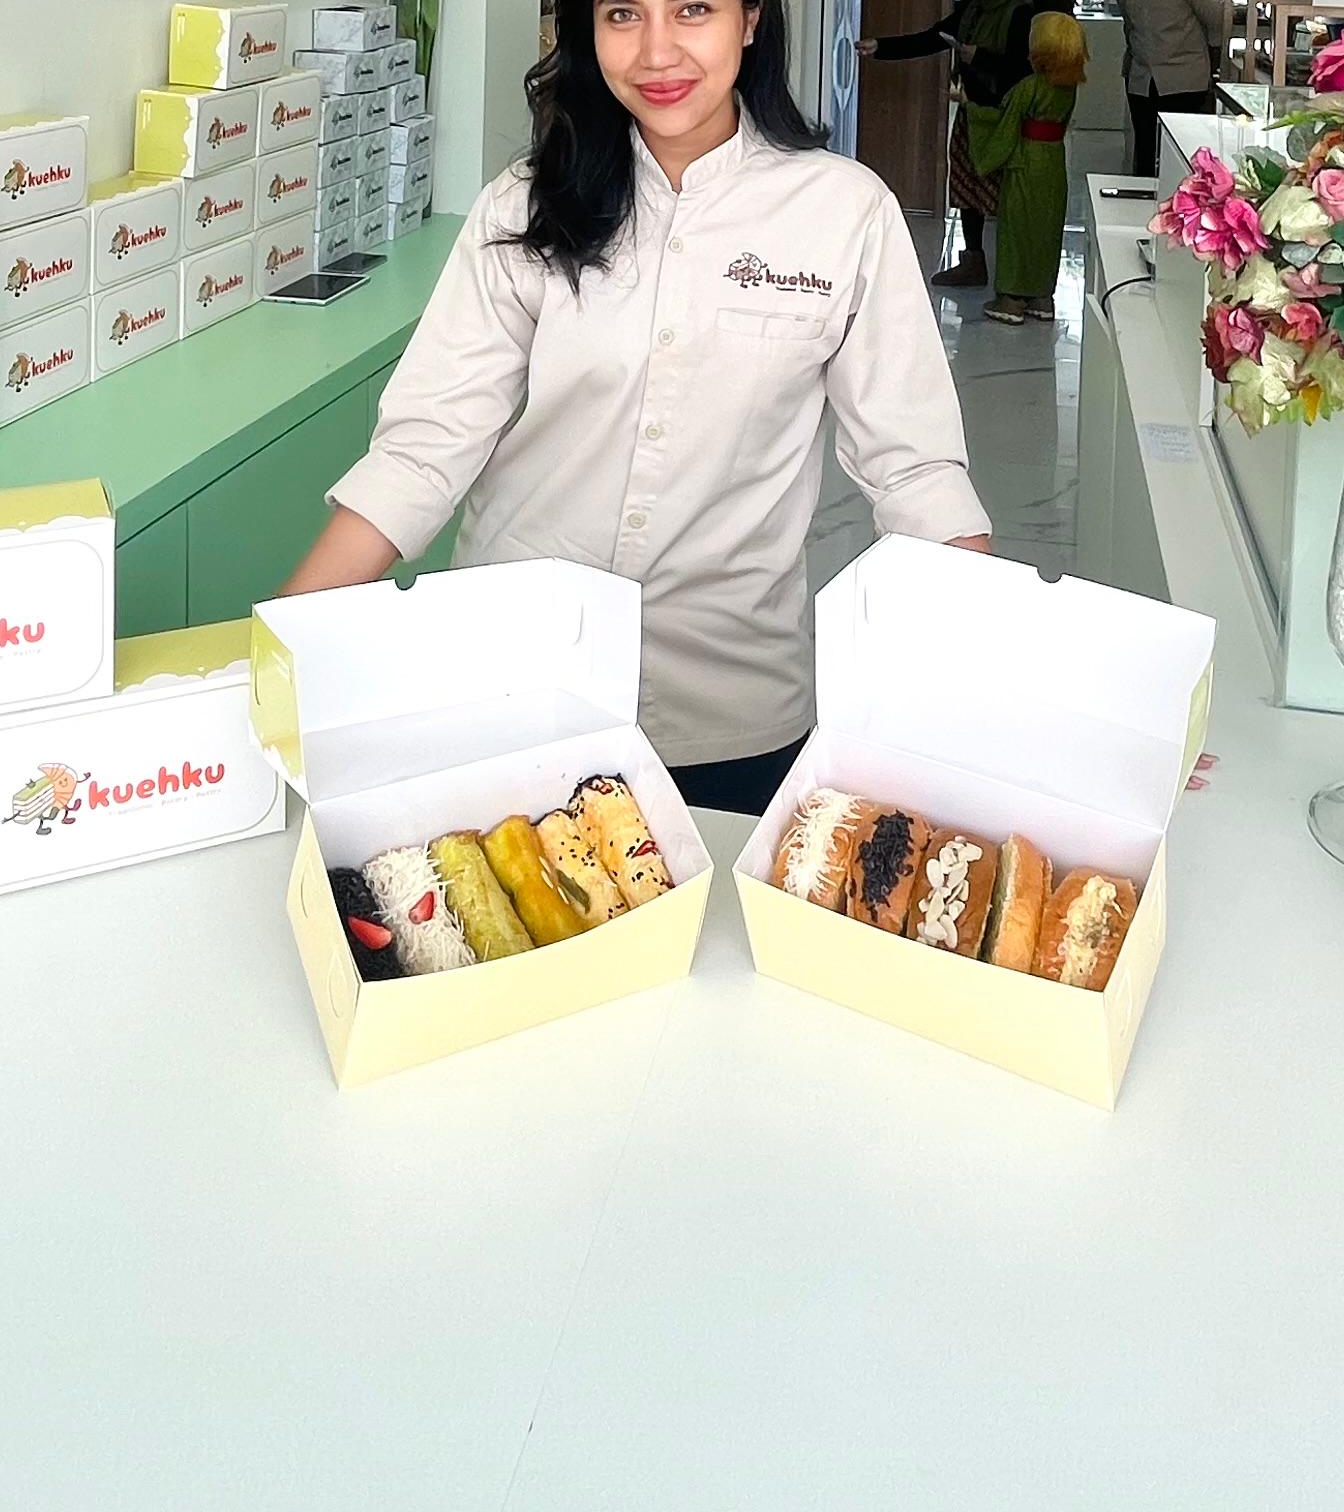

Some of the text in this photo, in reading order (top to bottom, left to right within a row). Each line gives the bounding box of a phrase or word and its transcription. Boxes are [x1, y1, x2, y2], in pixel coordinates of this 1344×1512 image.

[28, 165, 71, 188] kuehku
[31, 258, 73, 283] kuehku
[765, 268, 832, 291] kuehku
[31, 349, 74, 376] kuehku
[88, 761, 225, 809] kuehku
